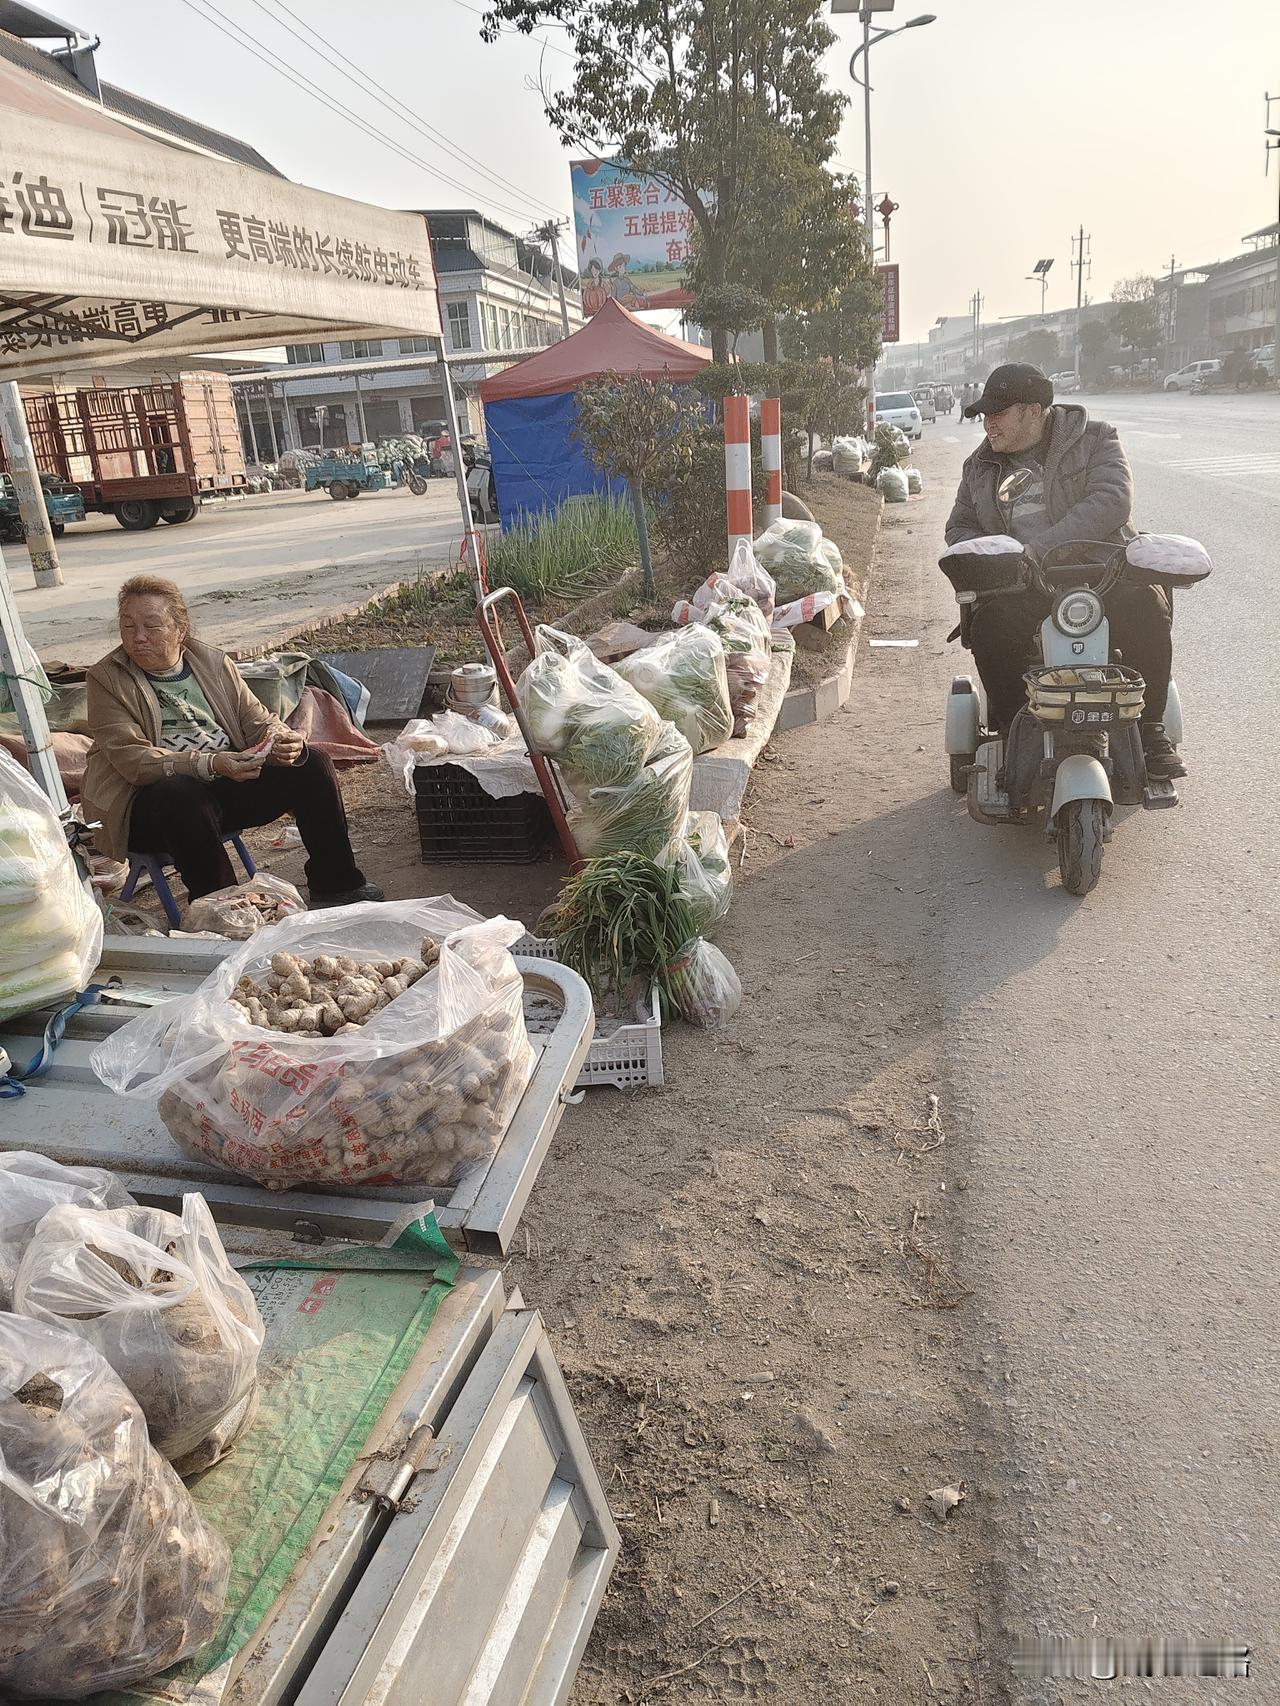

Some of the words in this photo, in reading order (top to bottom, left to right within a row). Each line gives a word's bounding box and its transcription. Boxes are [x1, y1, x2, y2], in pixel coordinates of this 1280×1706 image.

[0, 171, 75, 241] 迪
[96, 187, 200, 254] 冠能
[215, 209, 425, 291] 更高端的长续航电动车
[1086, 711, 1114, 722] 金彭
